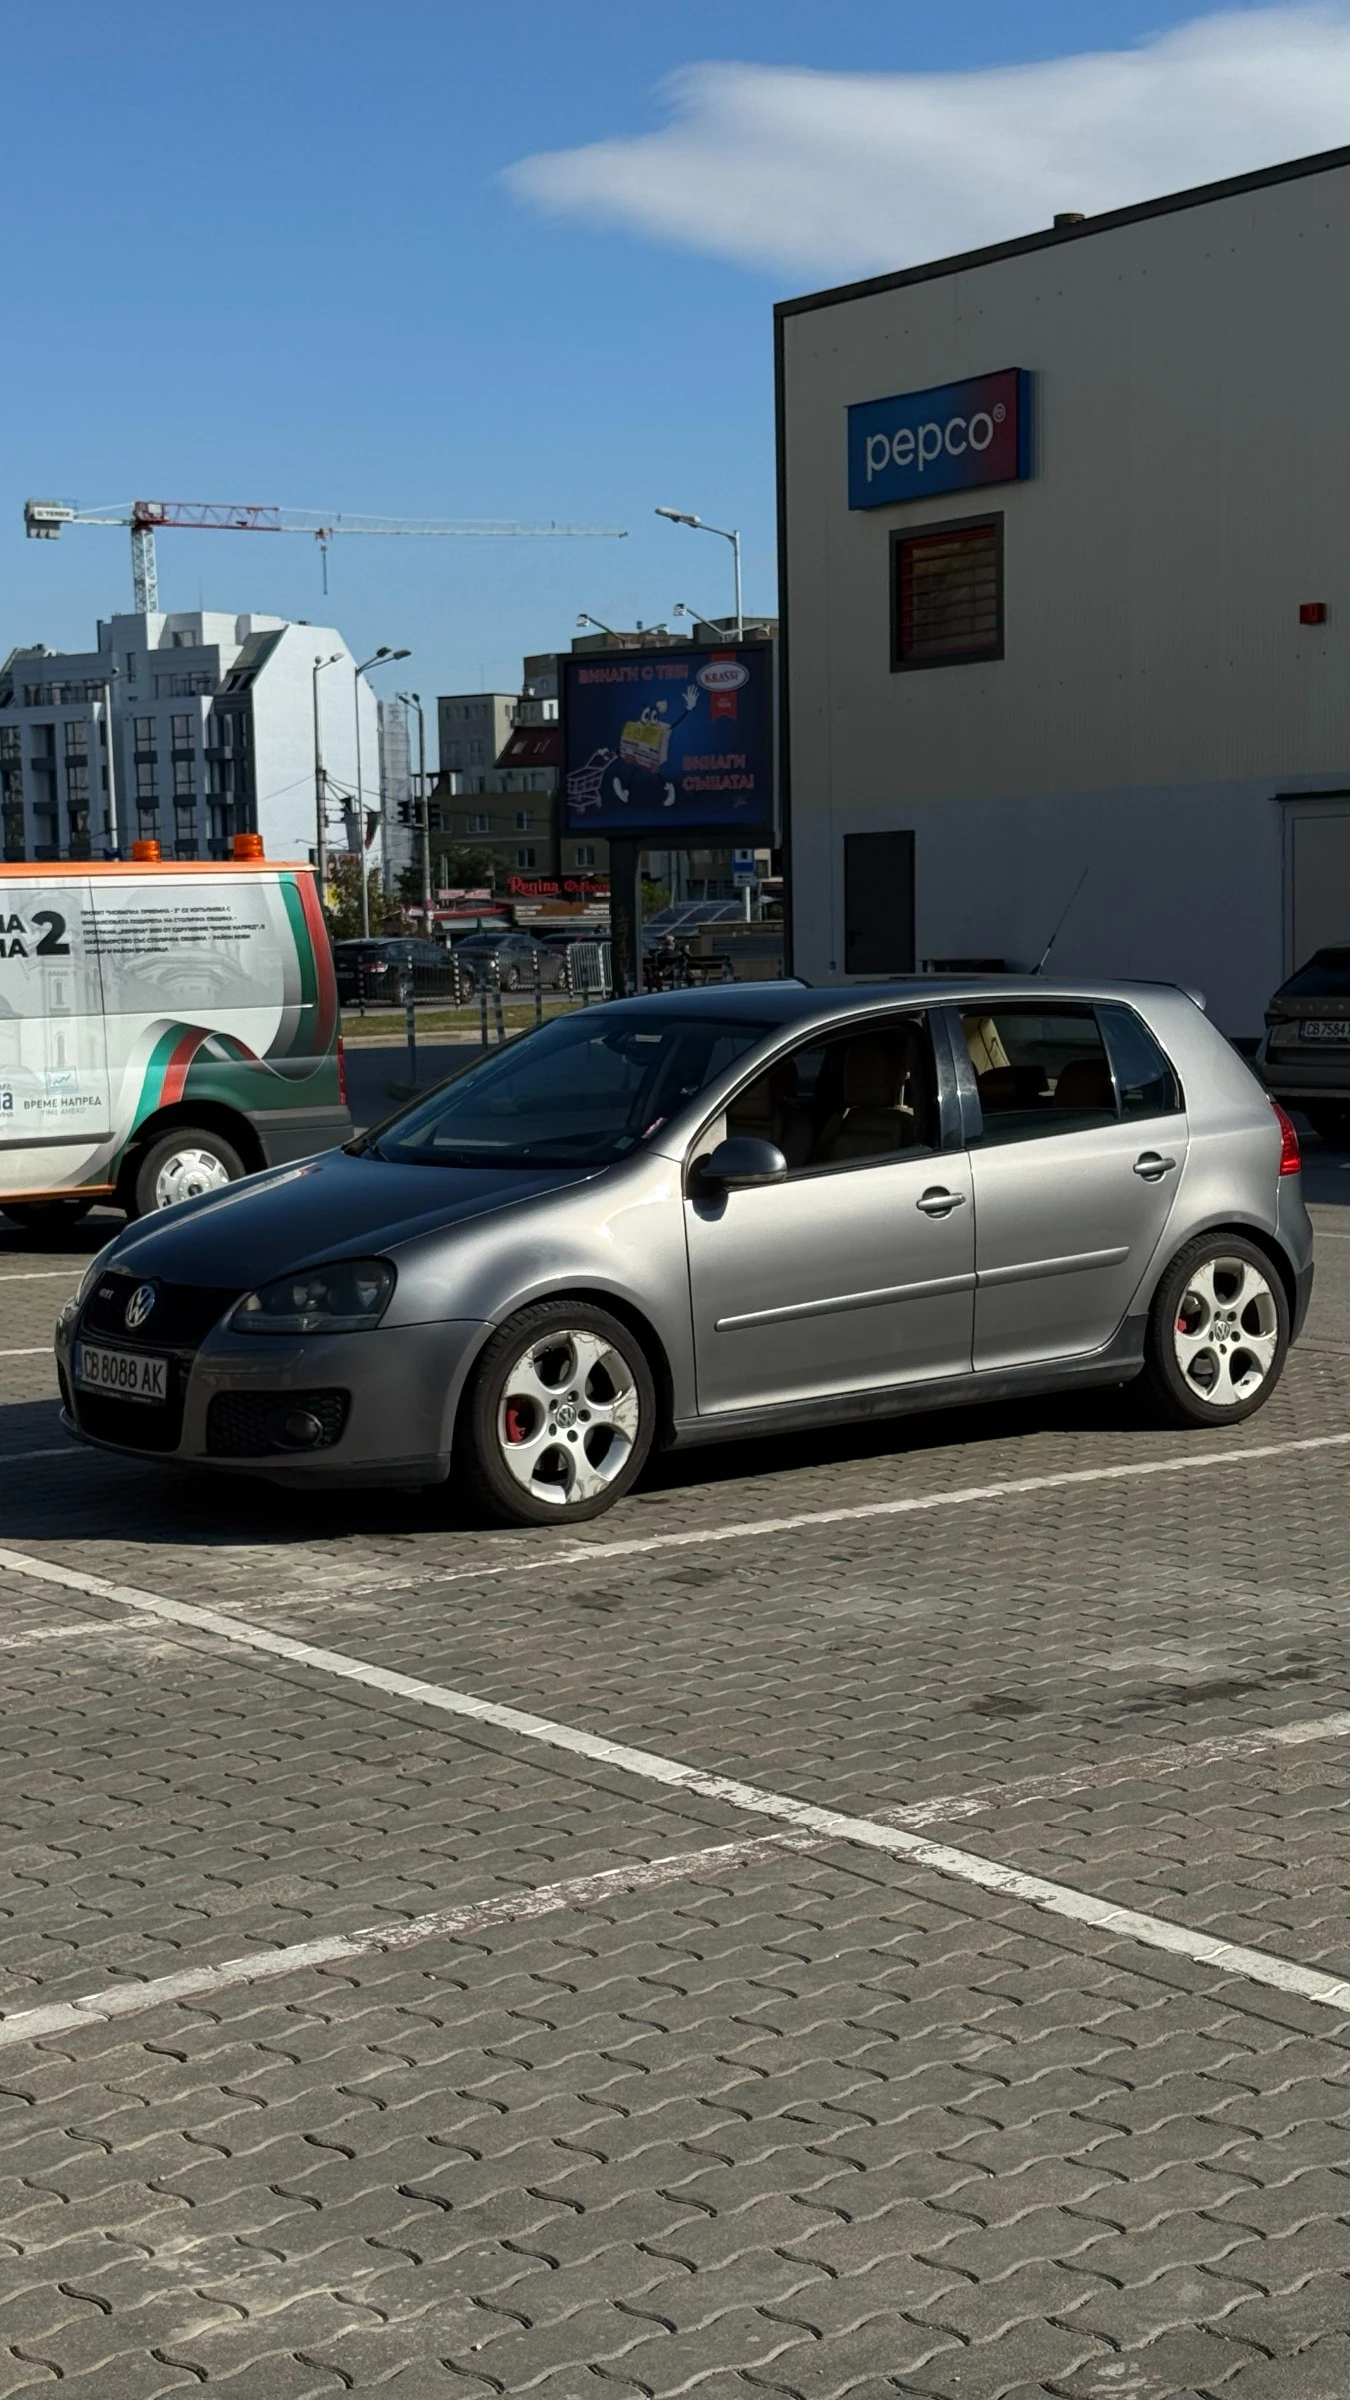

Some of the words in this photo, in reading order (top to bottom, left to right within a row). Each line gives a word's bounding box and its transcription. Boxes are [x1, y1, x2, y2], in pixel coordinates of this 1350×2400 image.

[641, 665, 654, 681] С
[682, 754, 746, 771] ВИНАГИ
[508, 876, 561, 897] Regina
[31, 911, 71, 956] 2
[23, 1099, 58, 1110] ВРЕМЕ
[60, 1096, 102, 1107] НАПРЕД
[84, 1350, 99, 1380] CB
[102, 1355, 137, 1388] 8088
[141, 1362, 163, 1394] AK
